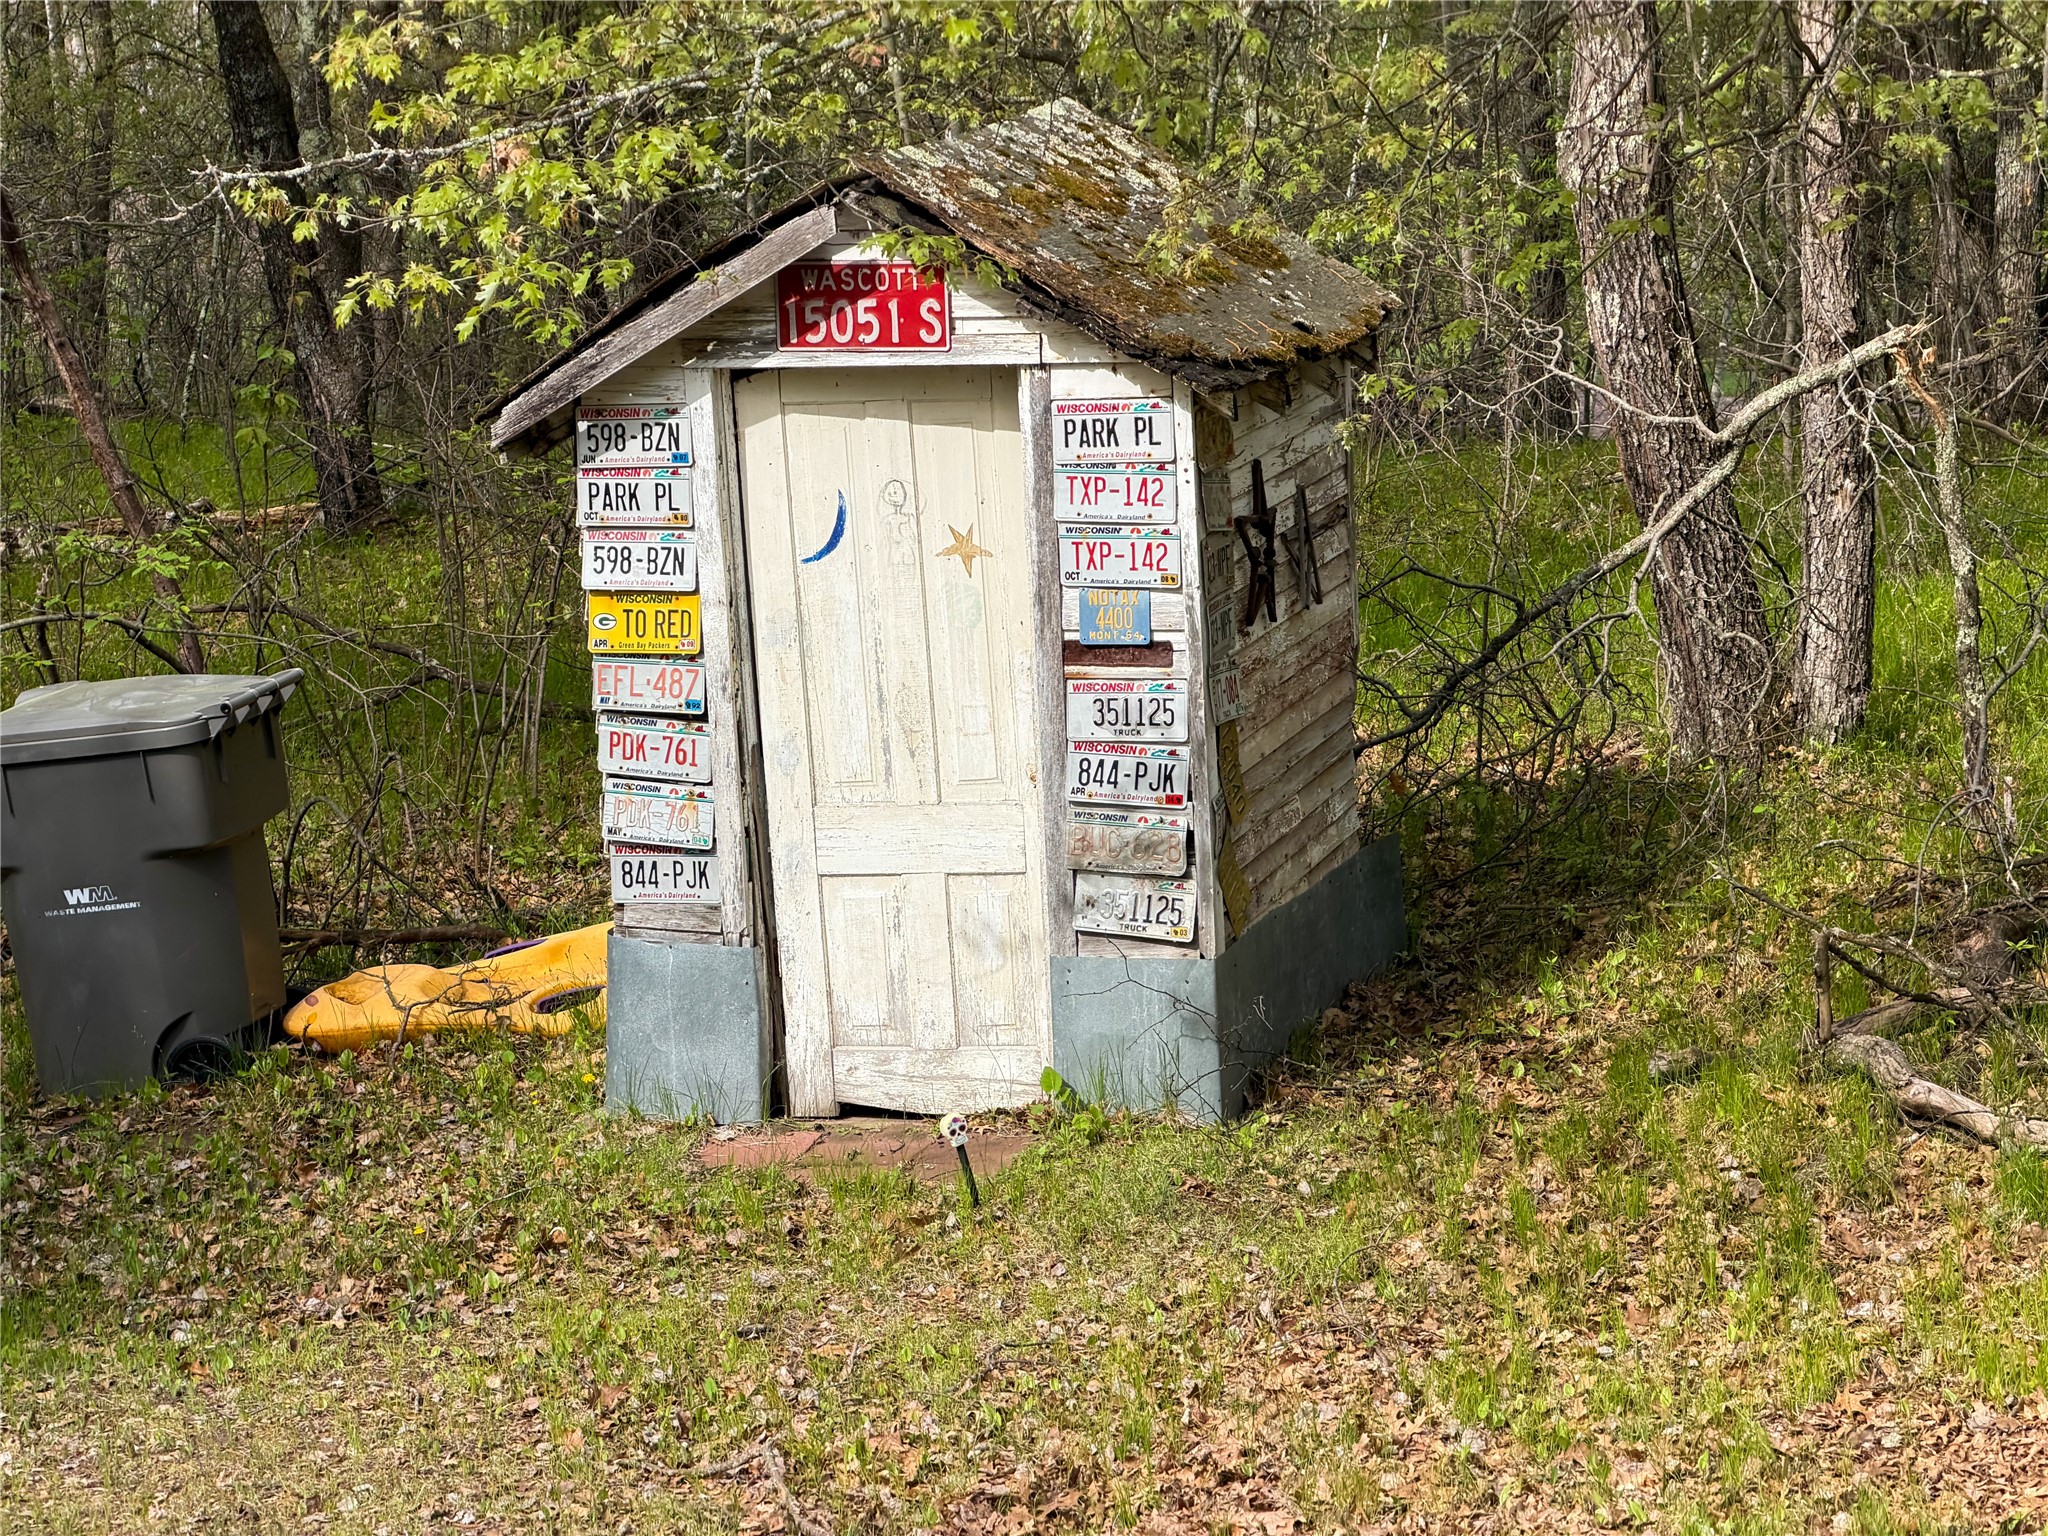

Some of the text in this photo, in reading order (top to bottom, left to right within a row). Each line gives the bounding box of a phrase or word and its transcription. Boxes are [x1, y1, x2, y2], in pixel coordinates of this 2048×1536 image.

[801, 267, 919, 291] WASCOTT
[786, 298, 942, 344] 15051 S
[580, 408, 640, 419] WISCONSIN
[1056, 402, 1119, 414] WISCONSIN
[587, 422, 680, 452] 598-BZN
[1064, 416, 1161, 448] PARK PL
[581, 455, 596, 464] JUN
[636, 455, 665, 463] Dairyland
[1115, 451, 1146, 459] Dairyland
[581, 468, 641, 478] WISCONSIN
[588, 482, 680, 511] PARK PL
[1066, 476, 1164, 507] TXP-142
[584, 512, 598, 520] OCT
[637, 515, 666, 523] Dairyland
[588, 531, 647, 541] WISCONSIN
[1066, 527, 1122, 535] WISCONSIN
[593, 545, 685, 576] 598-BZN
[1071, 541, 1168, 571] TXP-142
[1065, 572, 1080, 581] OCT
[640, 579, 669, 587] Dairyland
[616, 594, 673, 604] WISCONSIN
[622, 609, 691, 639] TO RED
[1096, 607, 1133, 630] 4400
[1089, 631, 1118, 640] MONT
[593, 639, 608, 648] APR
[636, 642, 646, 650] Bay
[1072, 682, 1134, 692] WISCONSIN
[1093, 697, 1175, 727] 351125
[606, 715, 658, 727] WISCONSIN
[609, 731, 698, 767] PDK-761
[1073, 742, 1137, 755] WISCONSIN
[657, 769, 684, 777] Dairyland
[1078, 757, 1176, 793] 844-PJK
[612, 782, 661, 793] WISCONSIN
[1070, 787, 1086, 796] APR
[1094, 791, 1126, 800] America's
[613, 795, 700, 833] PDK-761
[1074, 811, 1128, 822] WISCONSIN
[607, 827, 621, 836] MAY
[615, 845, 672, 855] WISCONSIN
[621, 860, 710, 889] 844-PJK
[63, 885, 114, 905] WM
[668, 892, 696, 900] Dairyland
[77, 901, 142, 914] MANAGEMENT
[1100, 888, 1183, 927] 351125
[1120, 923, 1147, 932] TRUCK
[1180, 929, 1187, 937] 03
